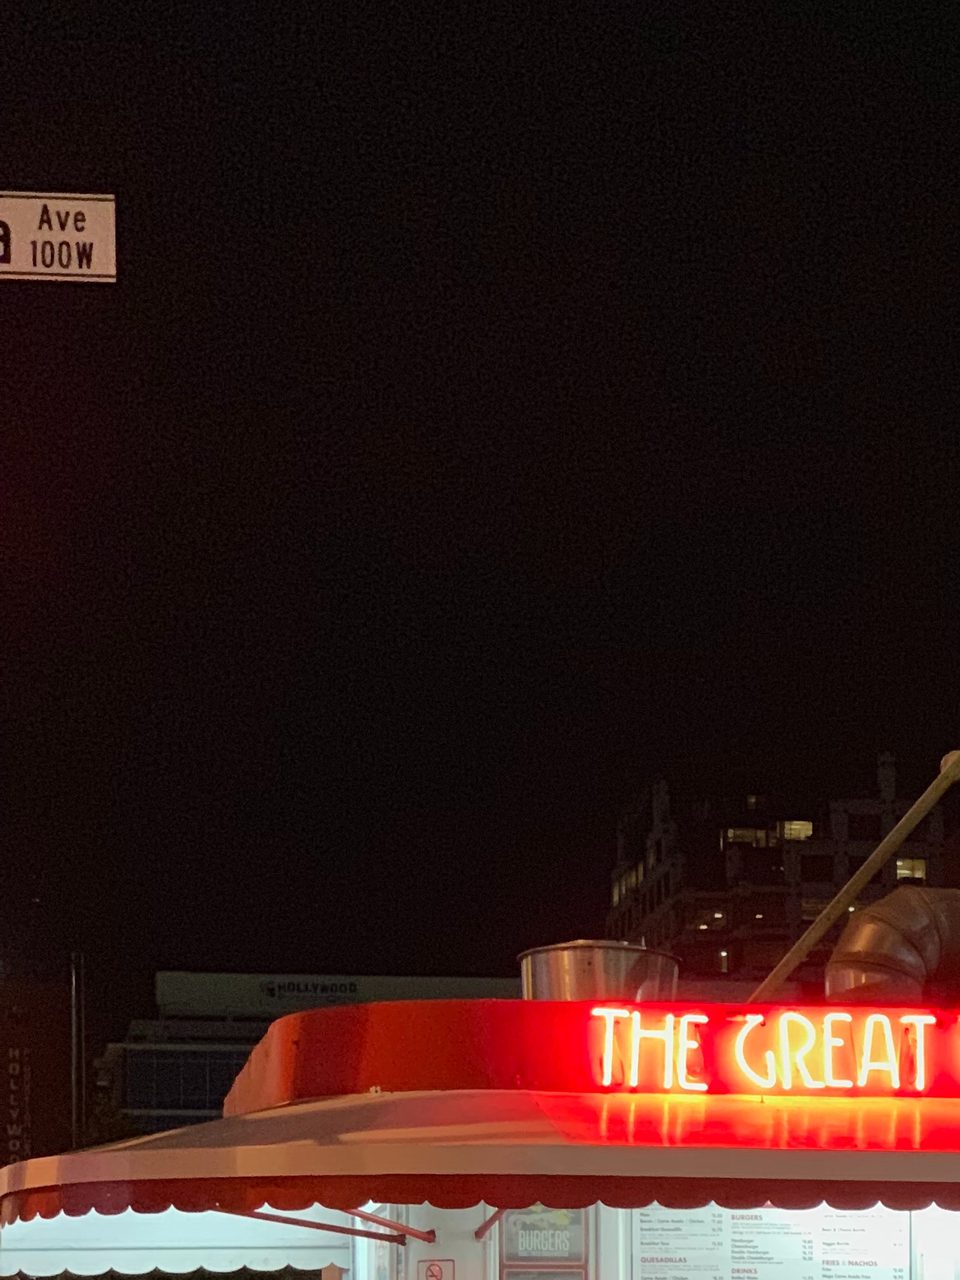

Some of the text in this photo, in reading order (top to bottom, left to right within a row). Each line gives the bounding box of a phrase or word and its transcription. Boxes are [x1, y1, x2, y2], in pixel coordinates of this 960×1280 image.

[38, 203, 87, 232] Ave
[30, 239, 94, 269] 100W
[592, 1007, 710, 1093] THE
[726, 1011, 936, 1091] GREAT
[518, 1230, 570, 1251] BURGERS
